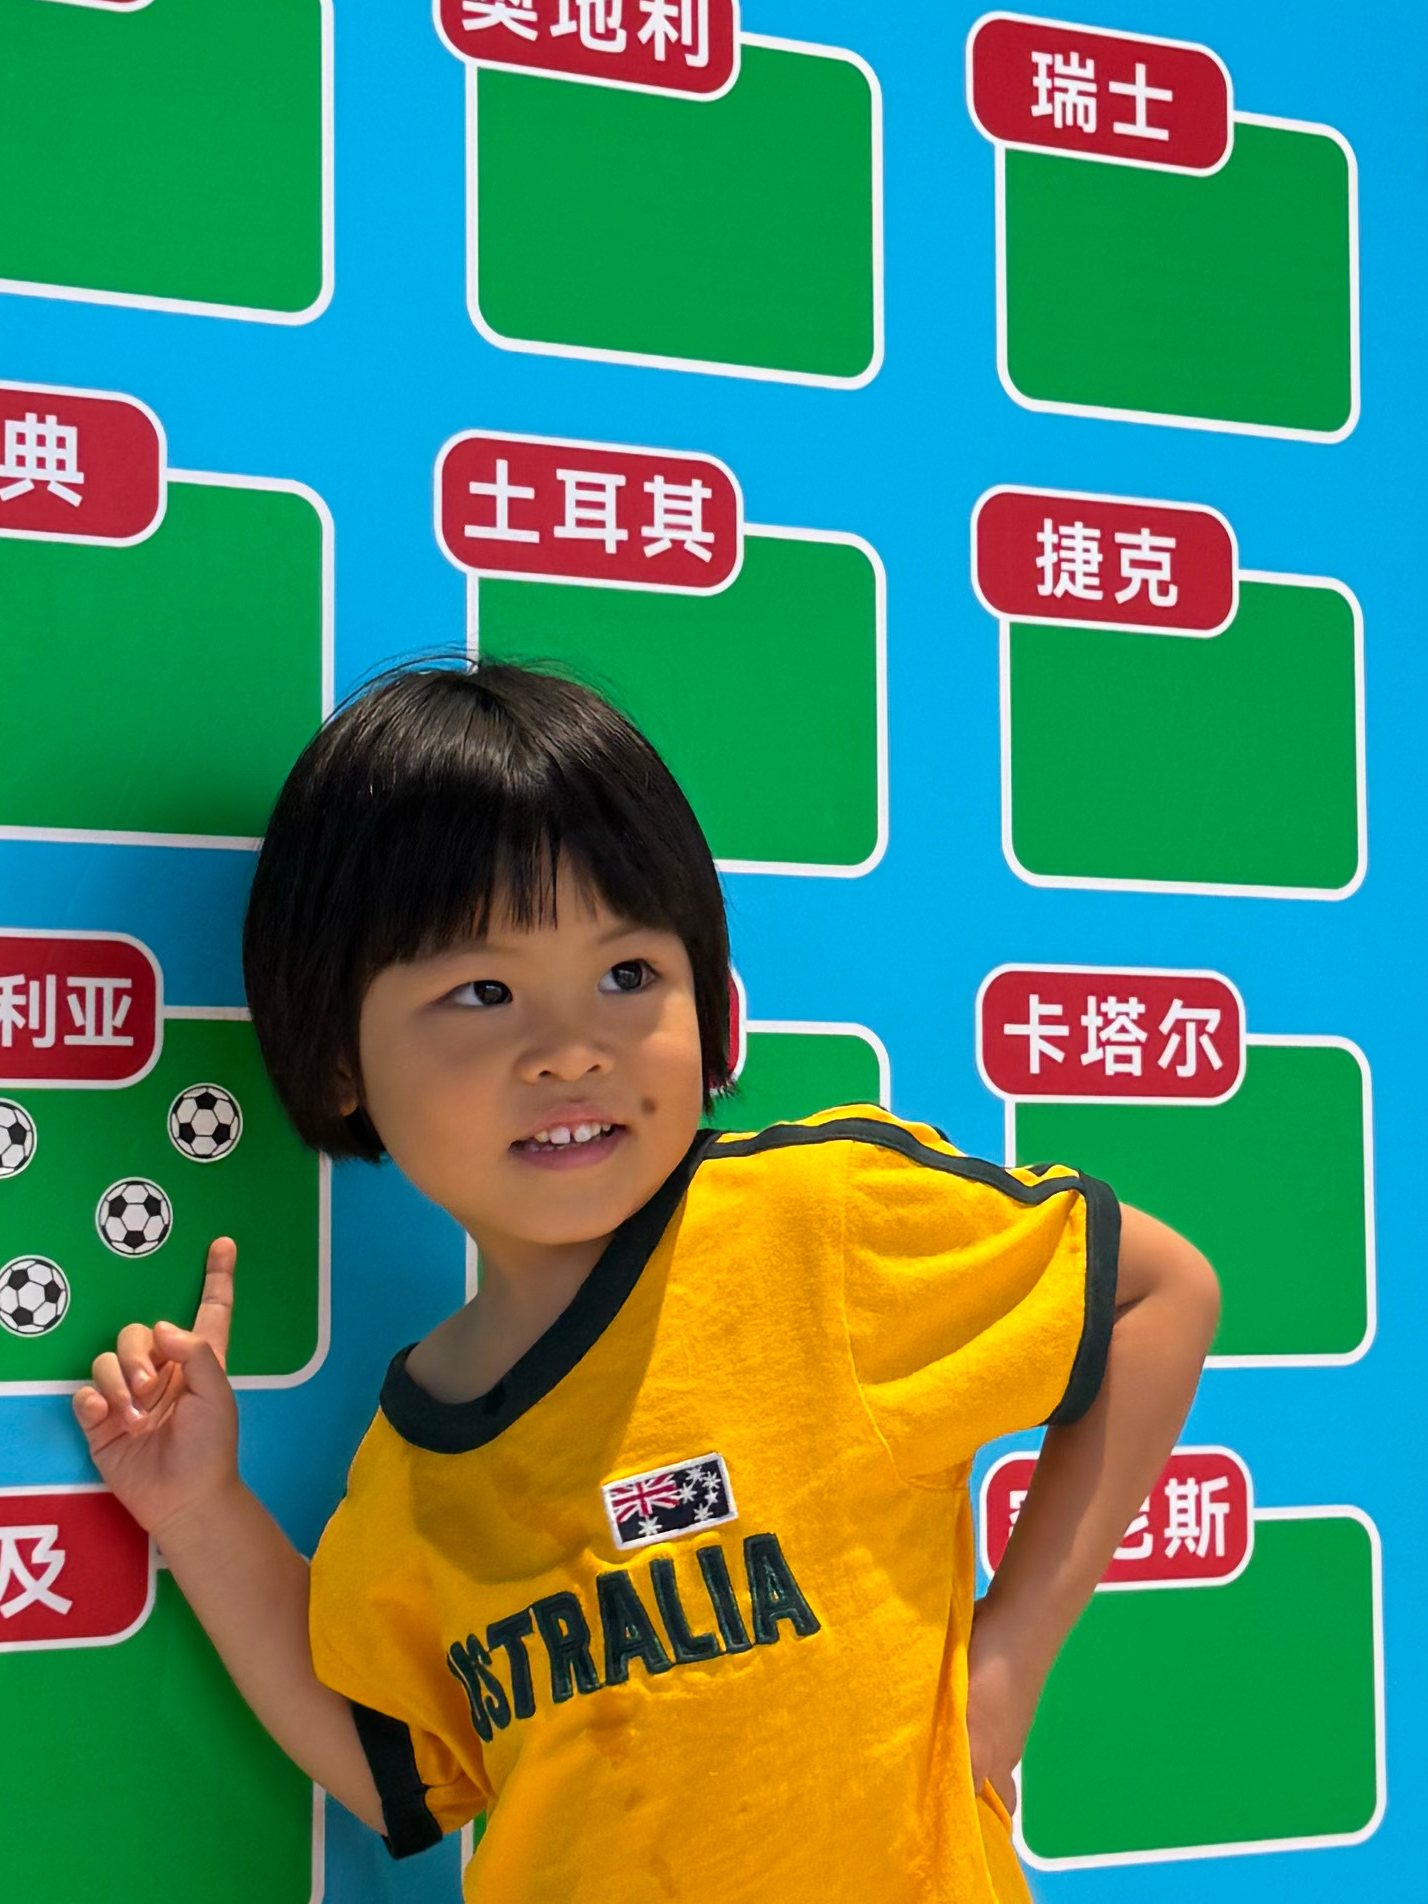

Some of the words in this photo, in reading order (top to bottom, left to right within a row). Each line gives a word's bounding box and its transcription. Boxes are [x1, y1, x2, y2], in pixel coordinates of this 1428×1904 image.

[1031, 52, 1172, 140] 瑞士
[464, 459, 714, 562] 土耳其
[1036, 518, 1178, 606] 捷克
[1006, 996, 1221, 1077] 卡塔尔
